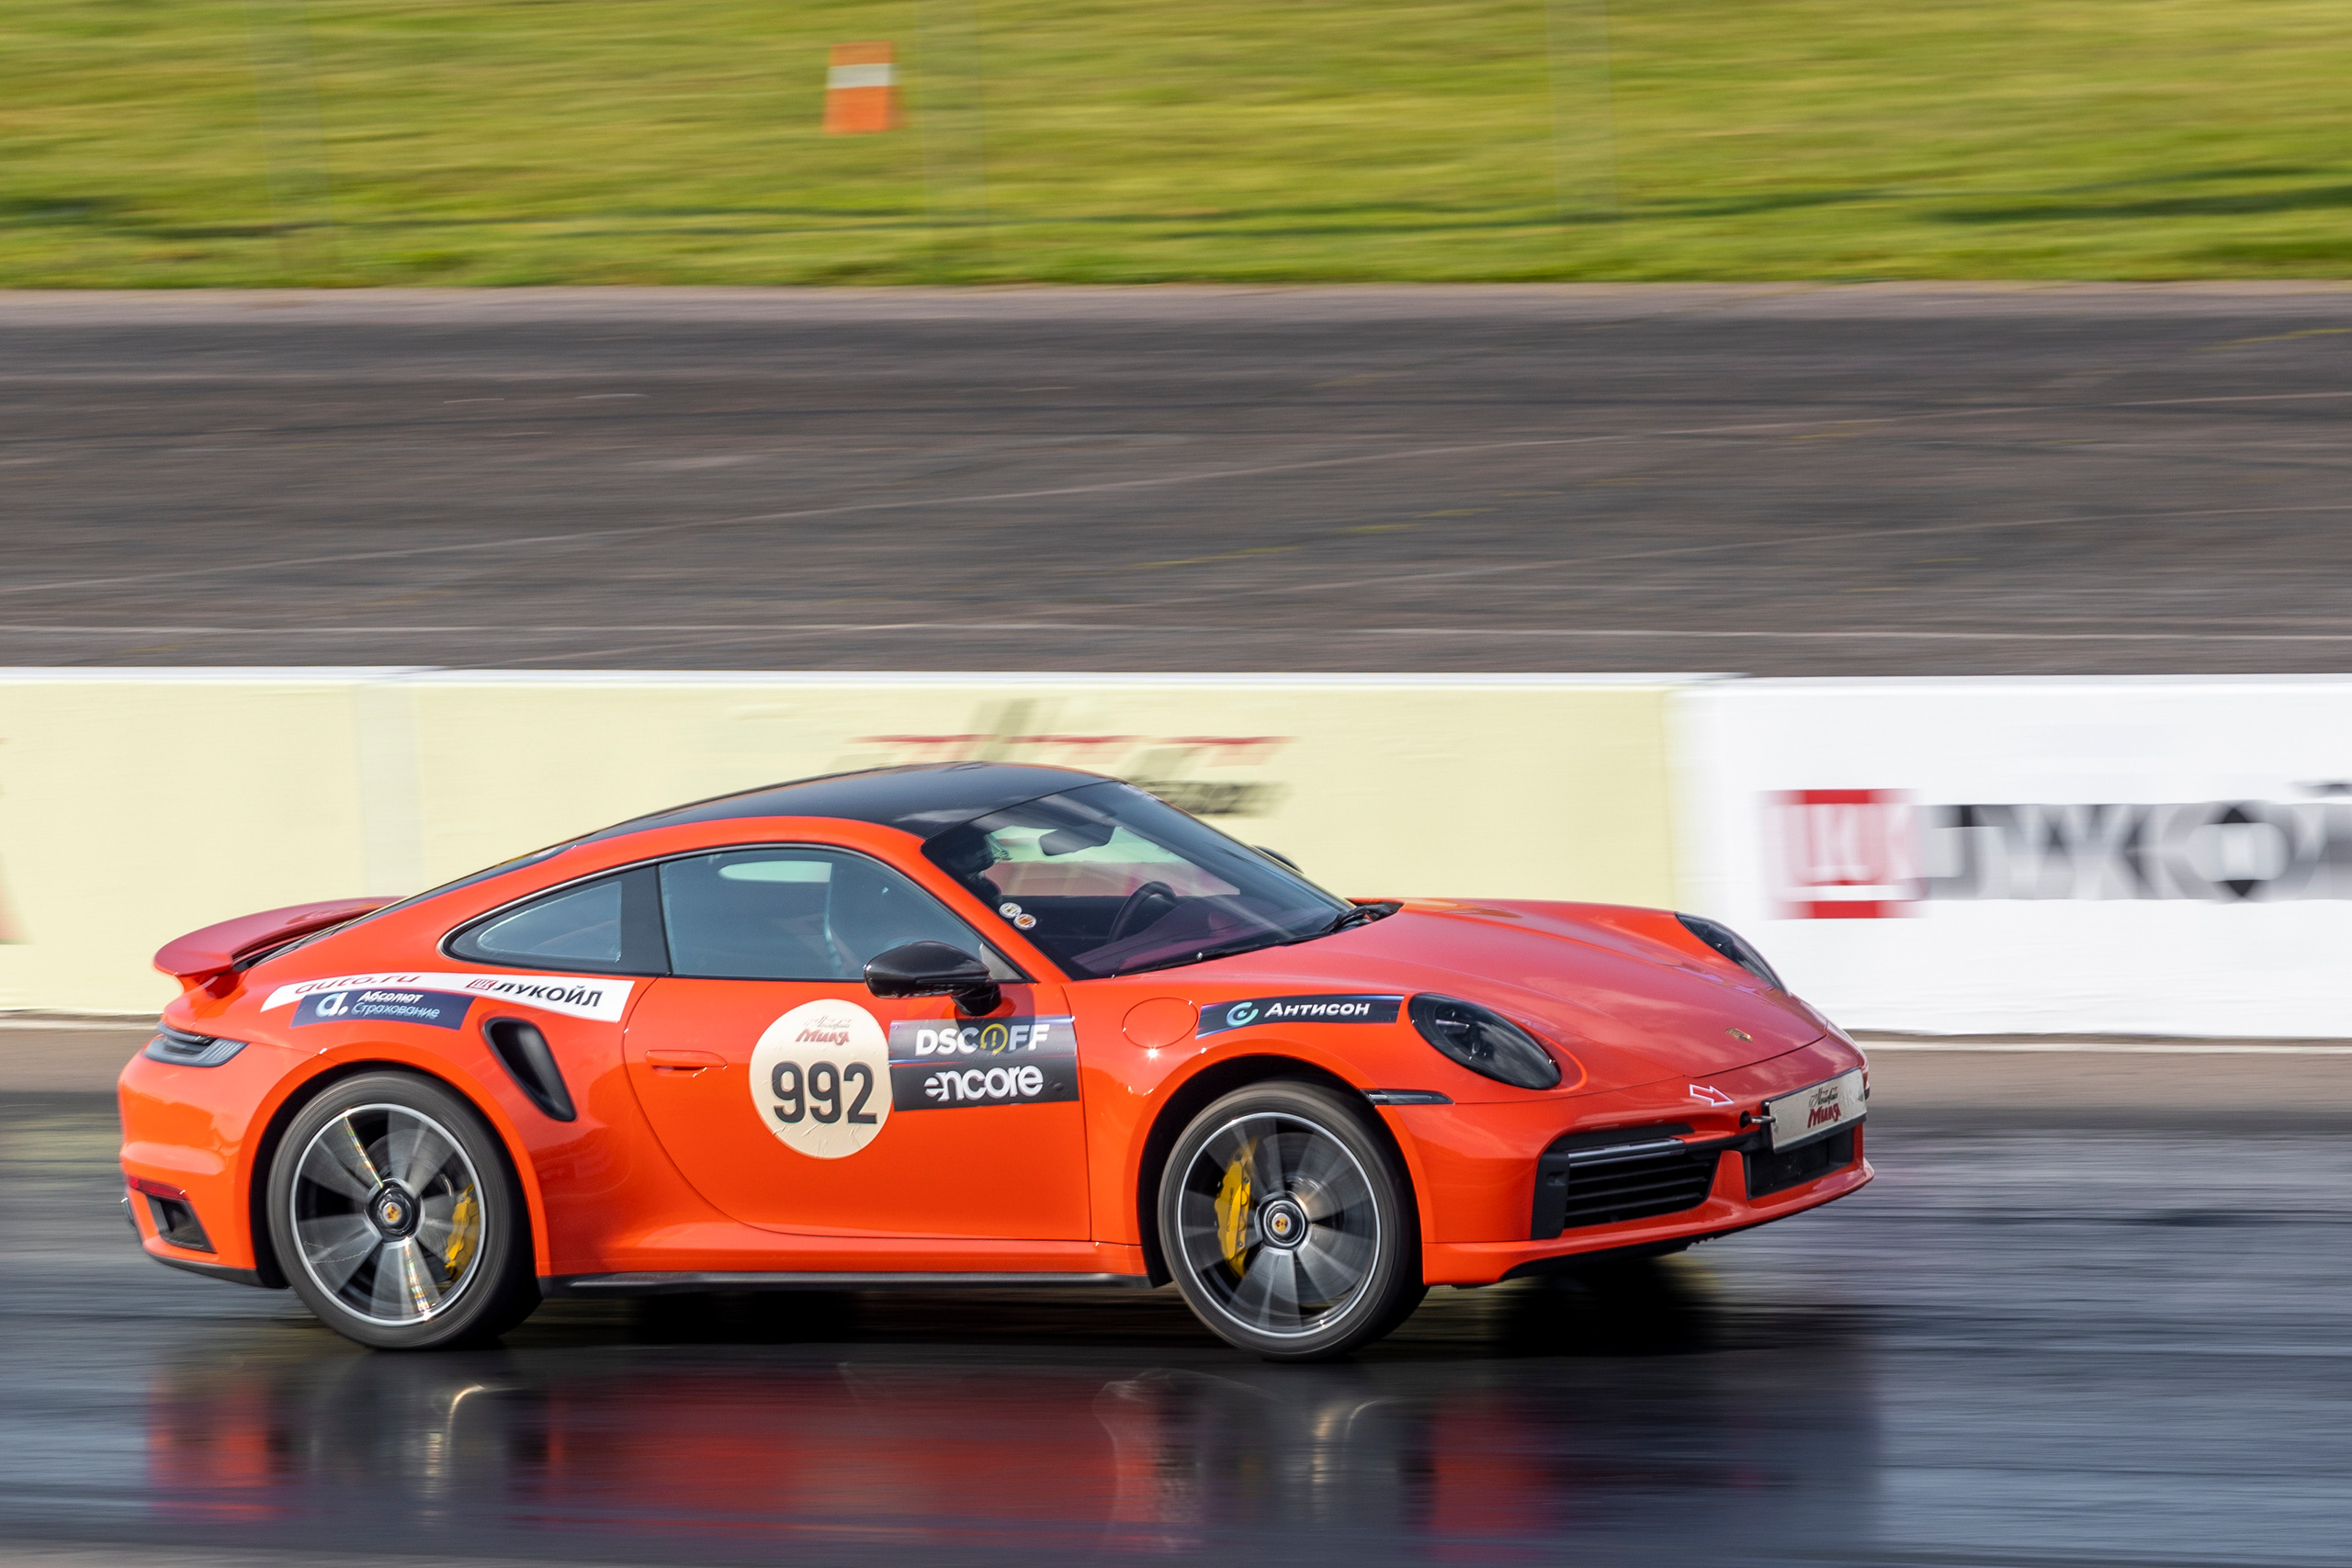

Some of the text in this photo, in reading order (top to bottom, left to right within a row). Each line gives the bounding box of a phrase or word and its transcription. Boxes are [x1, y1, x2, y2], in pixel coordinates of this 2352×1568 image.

[295, 975, 422, 994] auto.ru
[493, 982, 604, 1007] ЛУКОЙЛ
[357, 990, 424, 1005] Абсолют
[351, 1002, 440, 1020] Страхование
[771, 1061, 877, 1124] 992
[924, 1066, 1044, 1102] encore
